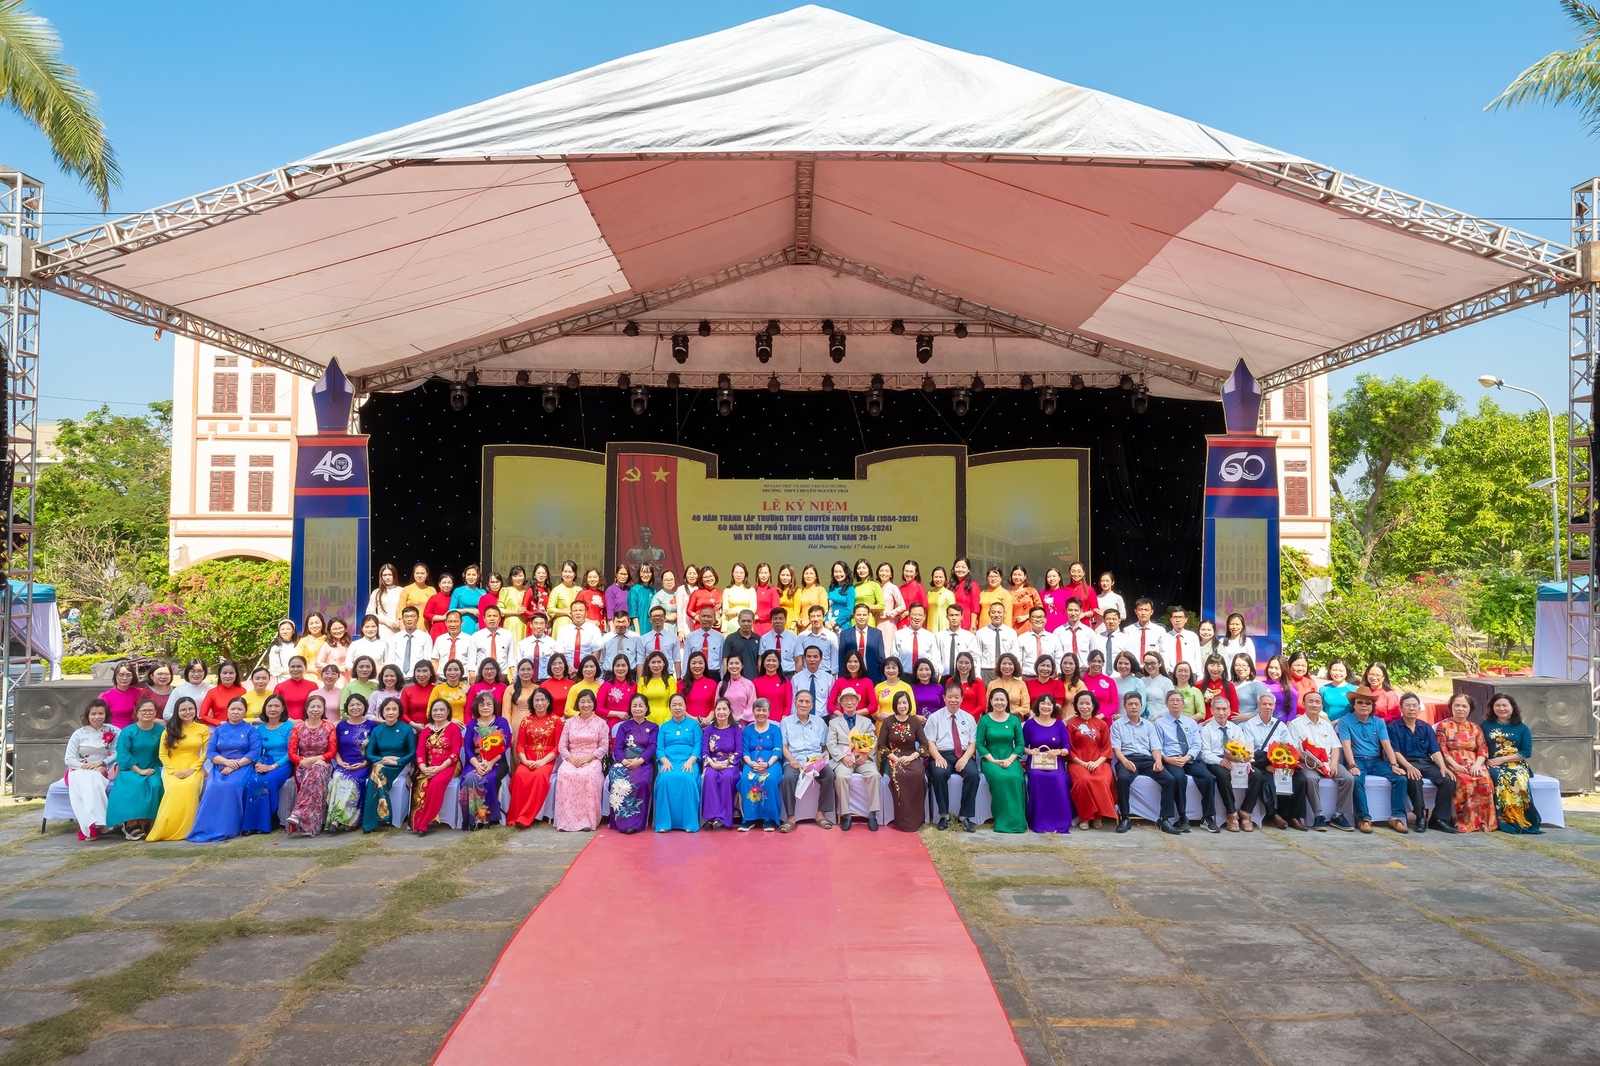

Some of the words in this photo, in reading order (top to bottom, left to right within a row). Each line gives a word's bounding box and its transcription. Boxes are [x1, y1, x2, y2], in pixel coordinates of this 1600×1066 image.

[1218, 451, 1266, 482] 60
[810, 500, 848, 513] NIỆM
[744, 514, 756, 523] LẬP
[804, 514, 830, 522] CHUYÊN
[755, 533, 771, 541] NIỆM
[826, 533, 840, 542] VIỆT
